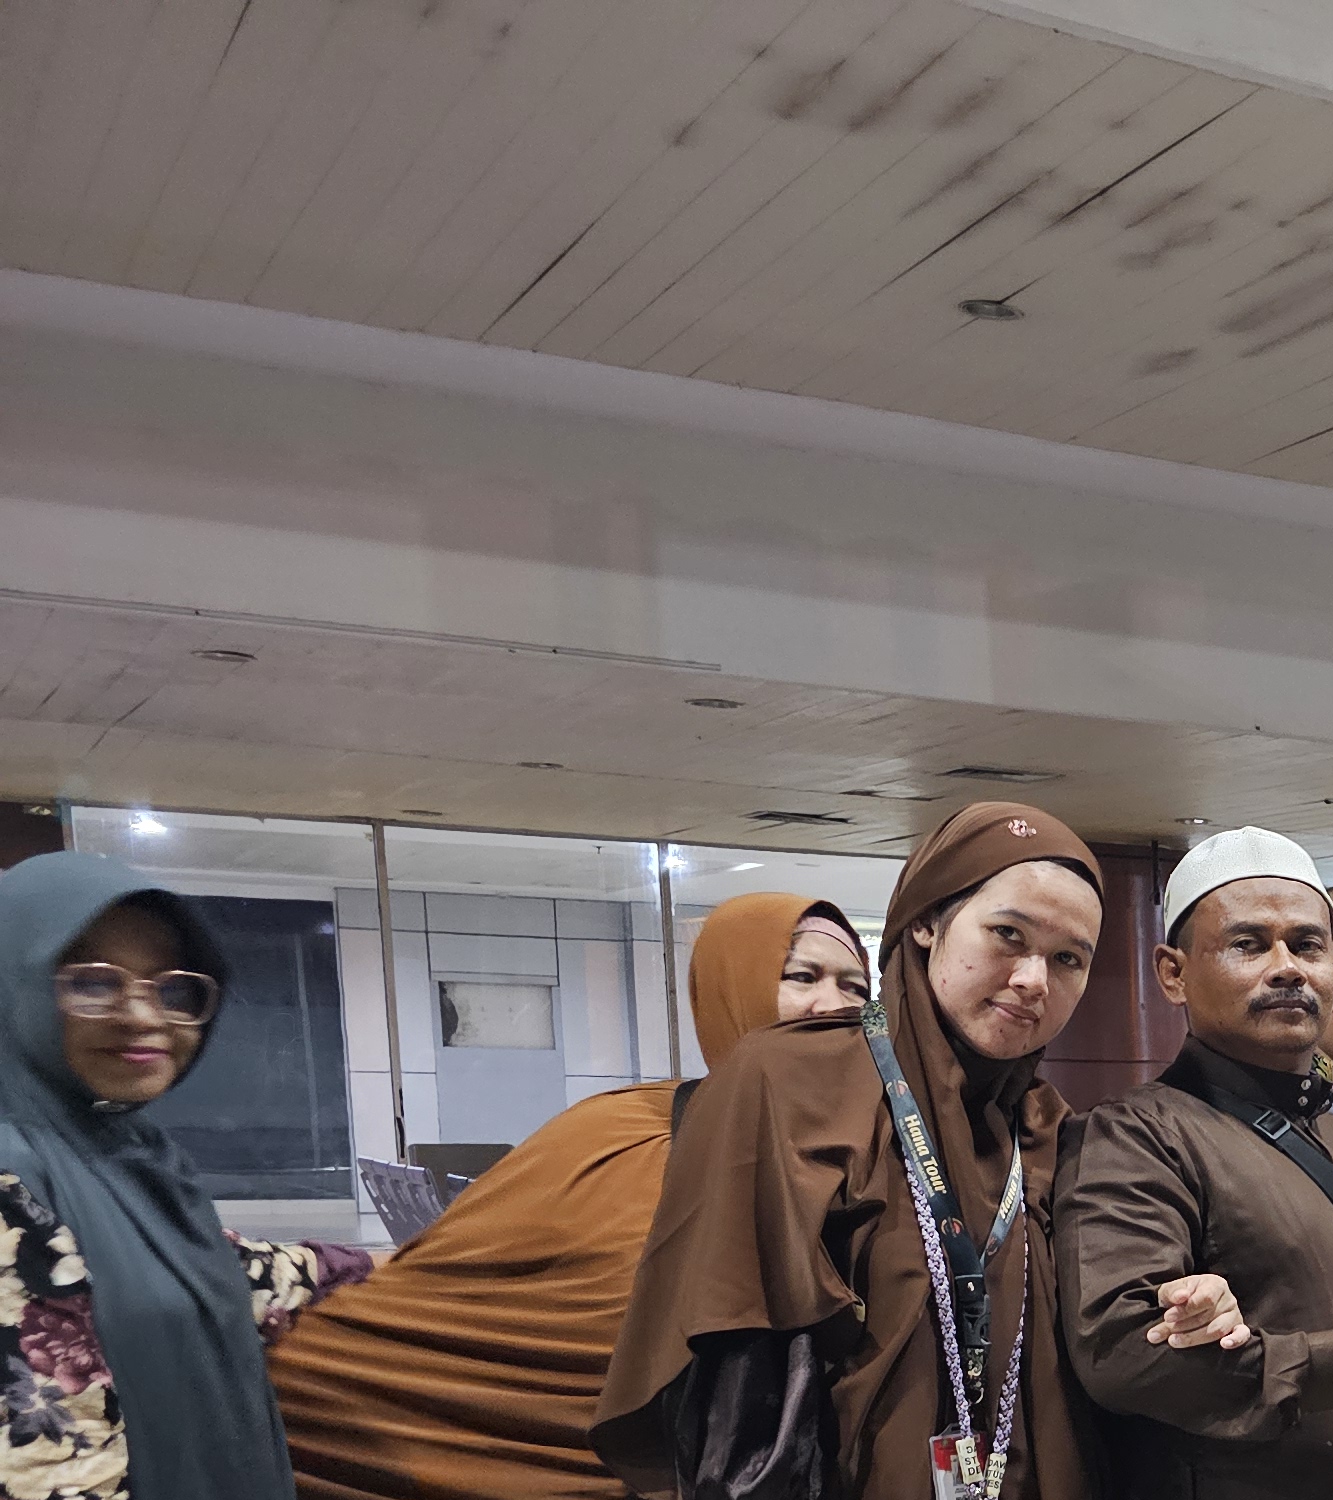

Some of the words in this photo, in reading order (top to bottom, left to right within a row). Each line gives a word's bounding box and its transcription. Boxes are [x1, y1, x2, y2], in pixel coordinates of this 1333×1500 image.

[904, 1114, 930, 1157] Hana
[923, 1156, 947, 1194] Tour
[999, 1181, 1018, 1219] Hana
